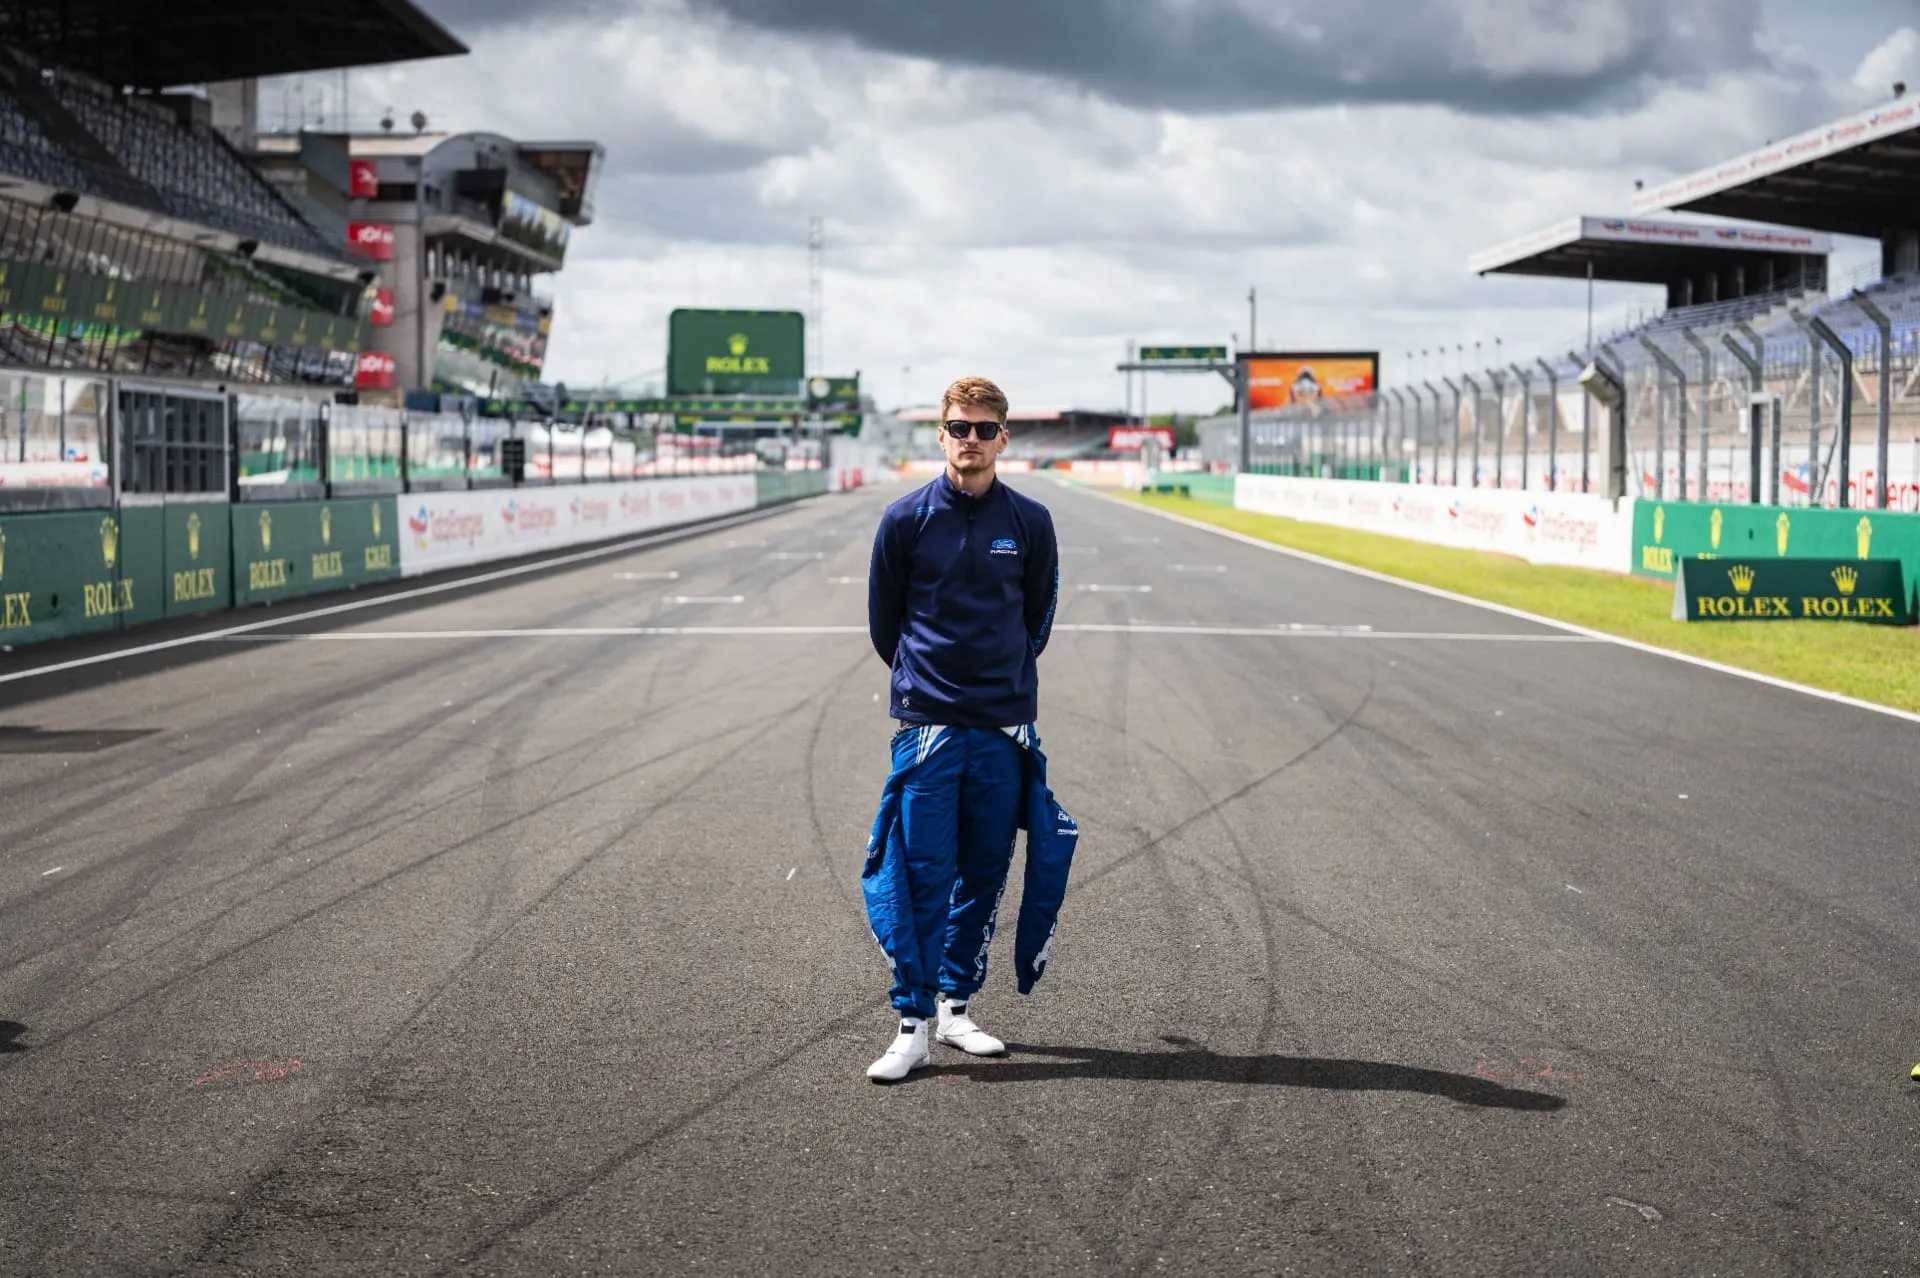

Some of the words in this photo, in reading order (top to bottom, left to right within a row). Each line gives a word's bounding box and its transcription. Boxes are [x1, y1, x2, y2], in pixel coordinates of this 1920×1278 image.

[173, 568, 215, 603] ROLEX
[1697, 596, 1792, 617] ROLEX
[1802, 597, 1895, 618] ROLEX
